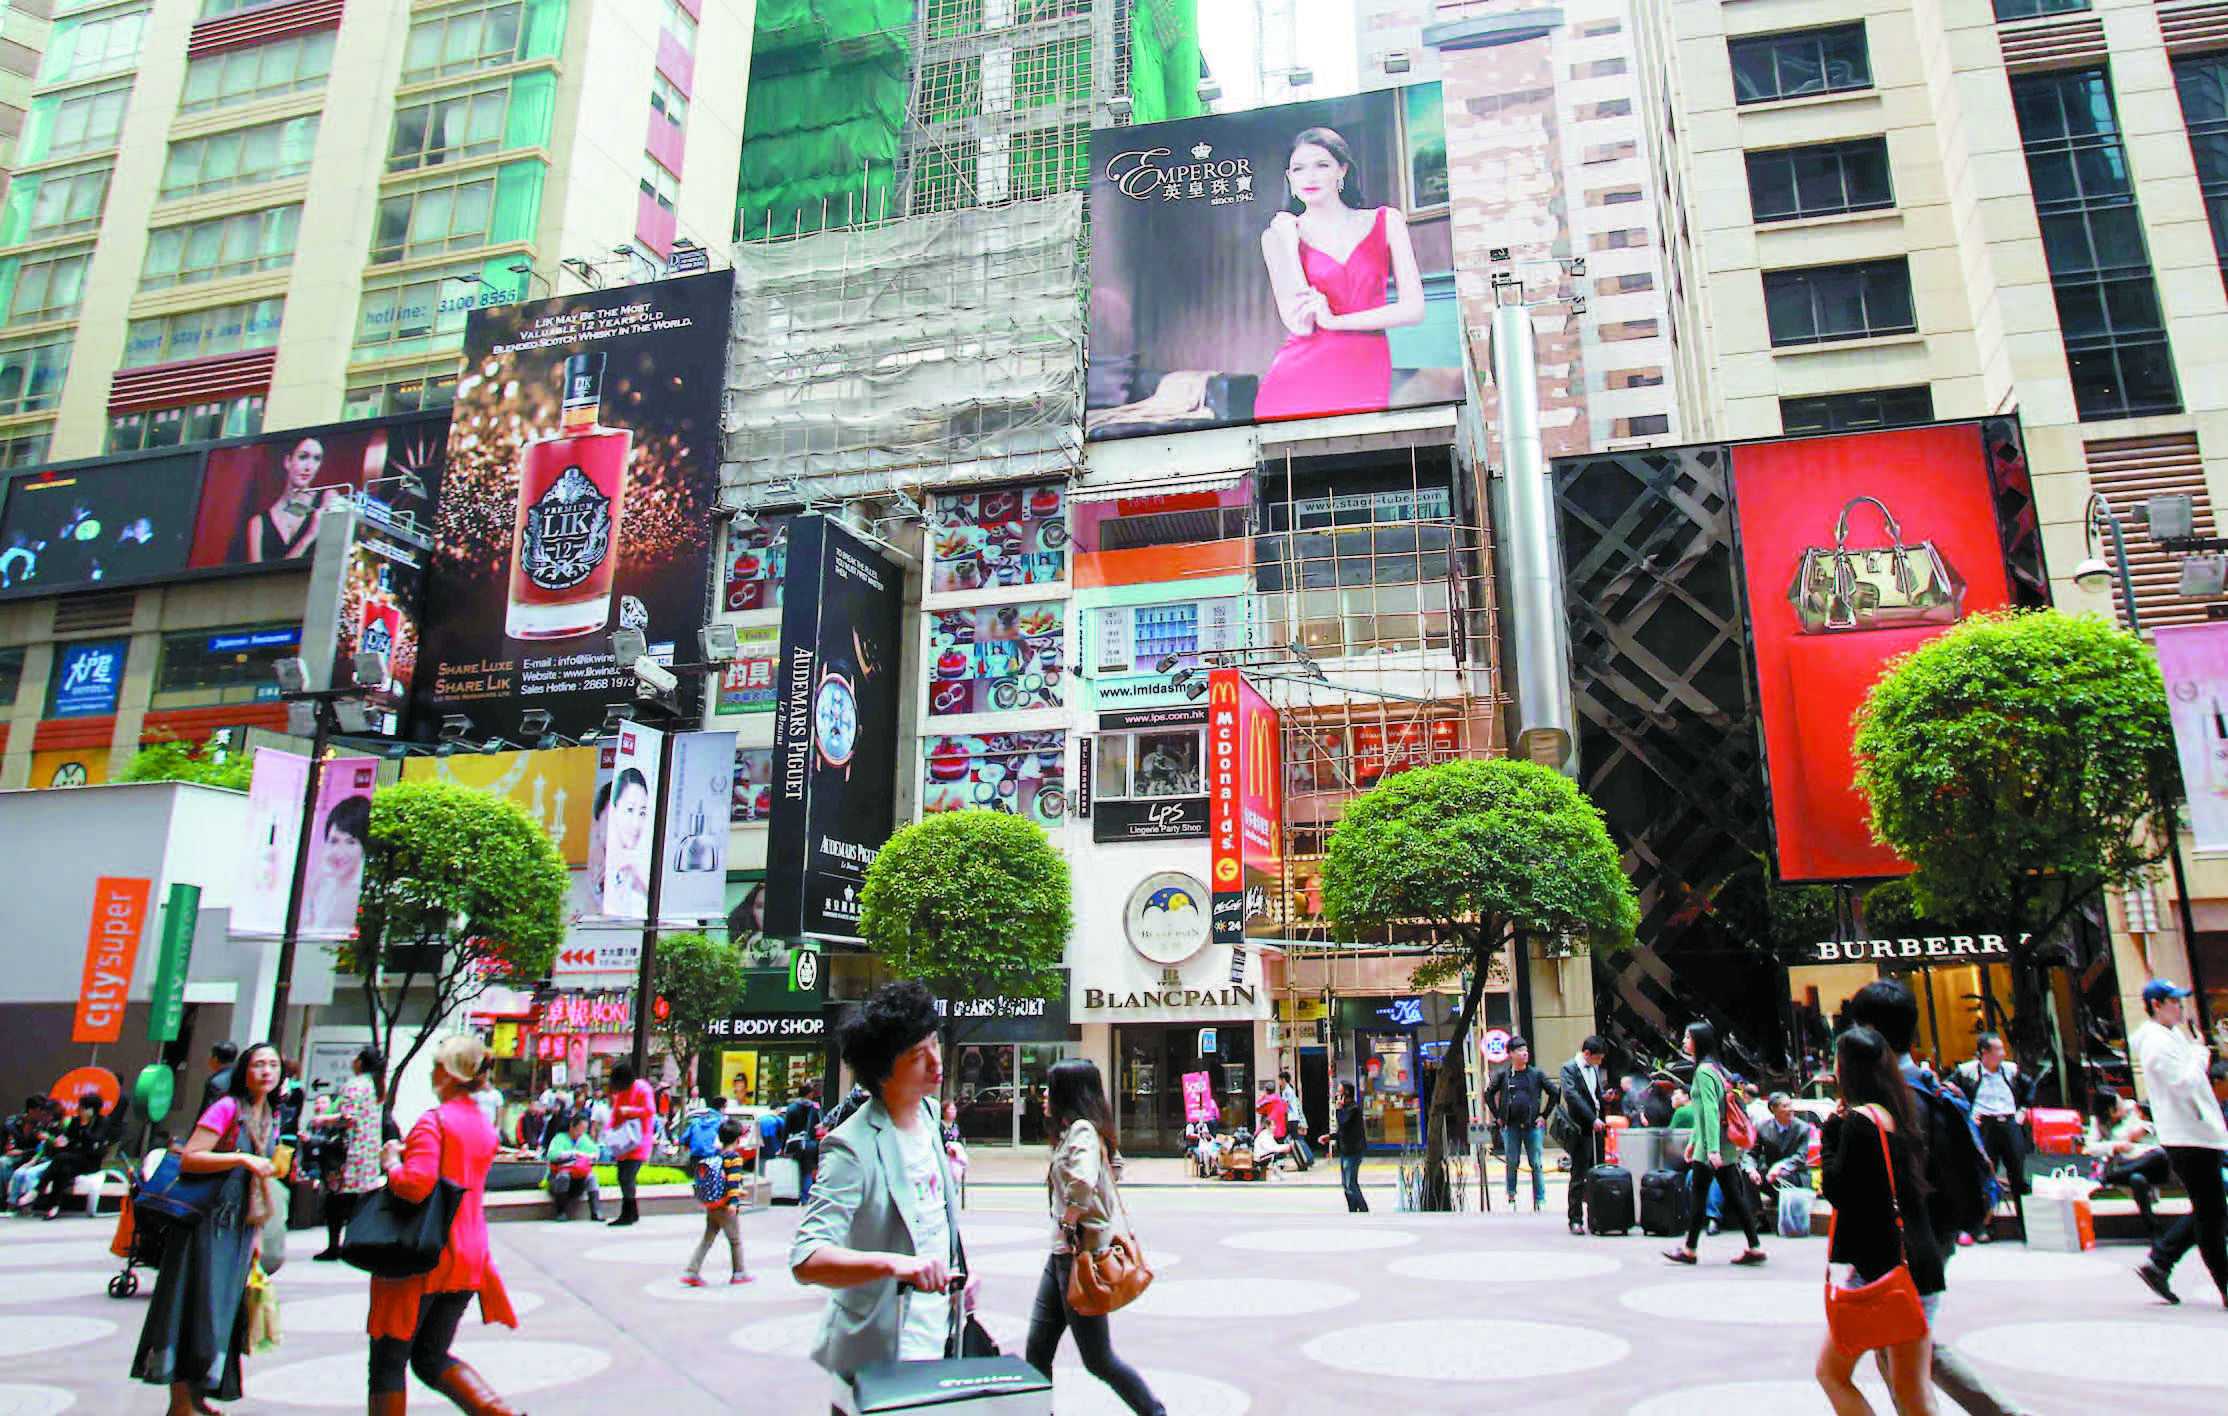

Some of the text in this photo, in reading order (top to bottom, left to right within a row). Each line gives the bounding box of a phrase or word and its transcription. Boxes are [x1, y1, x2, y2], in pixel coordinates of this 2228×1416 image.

[1106, 148, 1252, 199] EMPEROR
[1163, 176, 1252, 201] 英皇珠寶
[1211, 193, 1254, 206] since 1942
[366, 304, 426, 326] hotline:
[438, 297, 476, 313] 3100
[535, 303, 652, 329] LIK MAY BE THE MOST
[519, 311, 664, 341] VALUABLE 12 YEARS OLD
[492, 341, 537, 355] BLENDED
[538, 334, 577, 348] SCOTCH
[578, 327, 618, 341] WHISKY
[618, 326, 629, 336] IN
[630, 322, 651, 334] THE
[544, 502, 593, 515] PREMIUM
[542, 511, 592, 538] LIK
[555, 542, 572, 559] 12
[438, 659, 514, 676] SHARE LUXE
[522, 670, 557, 682] Website
[435, 675, 511, 695] SHARE LIK
[521, 675, 635, 695] Sales Hotline 2868 1973
[785, 646, 814, 800] AUDEMARS PIGUET
[1129, 822, 1202, 835] Lingerie Party Shop
[820, 835, 857, 860] AUDEMARS
[1141, 928, 1199, 939] BLANCPAIN
[1228, 920, 1242, 932] 24
[1816, 933, 2032, 960] BURBERR
[1084, 985, 1256, 1009] BLANCPAIN
[734, 1018, 778, 1035] BODY
